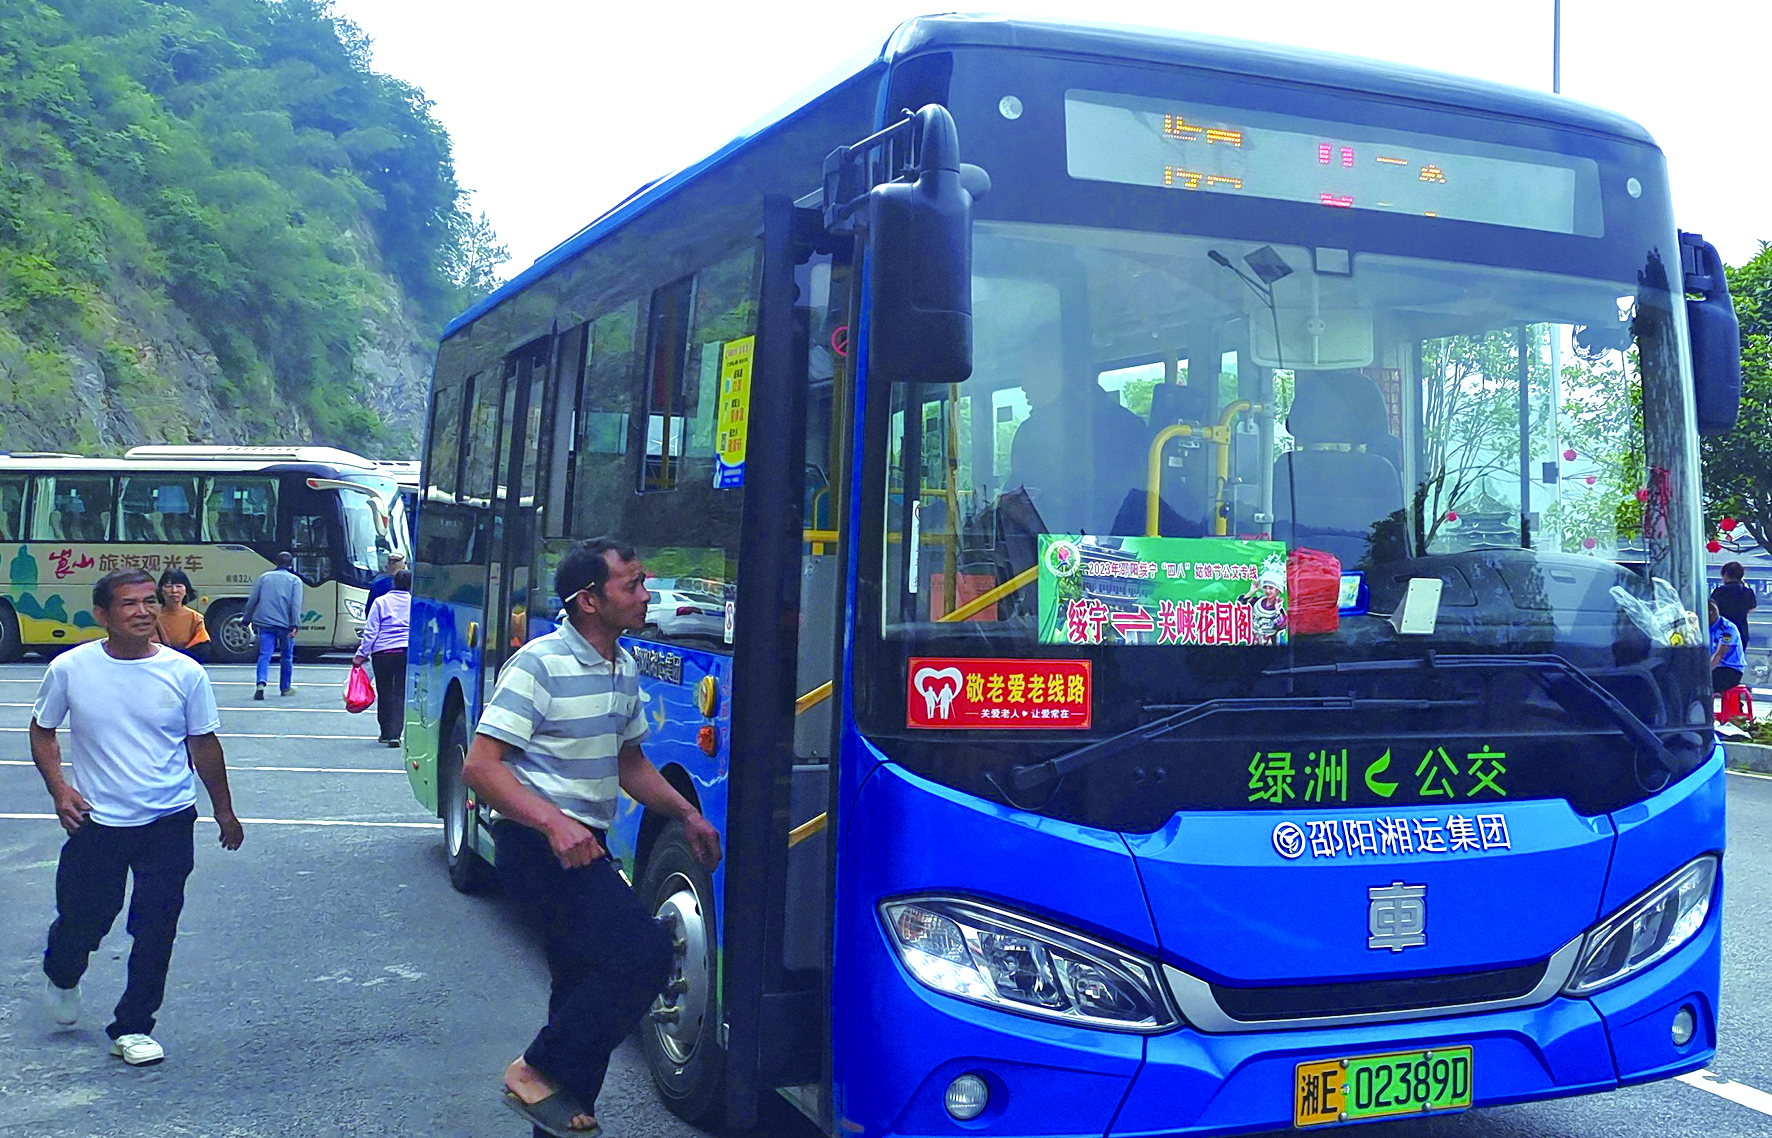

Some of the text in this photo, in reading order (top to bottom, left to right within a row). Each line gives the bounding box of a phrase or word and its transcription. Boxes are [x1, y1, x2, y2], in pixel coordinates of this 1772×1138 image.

[98, 553, 204, 573] 旅游观光车
[1066, 599, 1253, 645] 绥宁 关峡花园阁
[966, 673, 1086, 704] 敬老爱老线路
[980, 708, 1070, 719] 关爱老人 让爱常在
[1247, 744, 1507, 804] 绿洲 公交
[1306, 813, 1512, 858] 邵阳湘运集团
